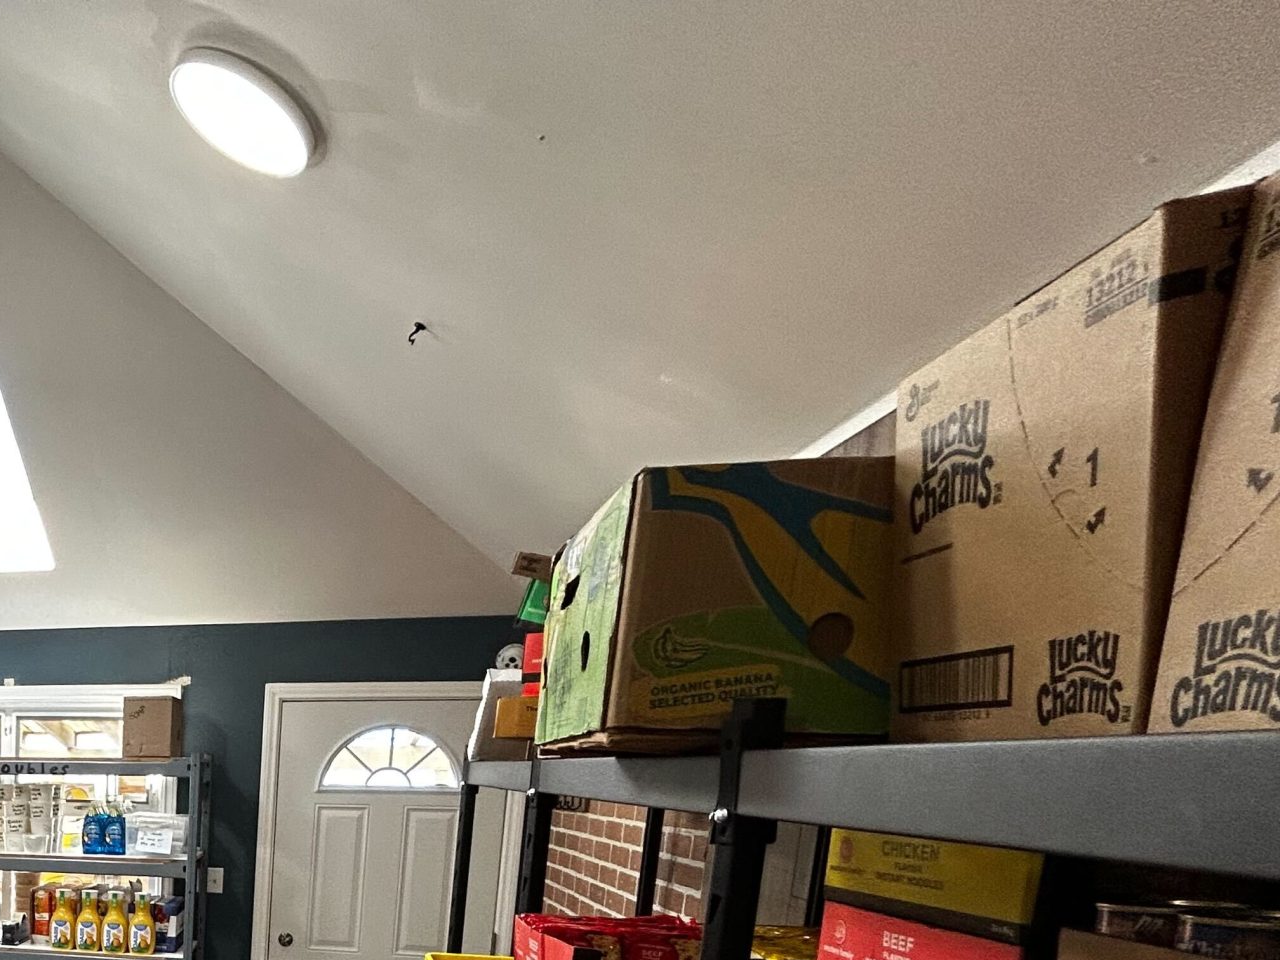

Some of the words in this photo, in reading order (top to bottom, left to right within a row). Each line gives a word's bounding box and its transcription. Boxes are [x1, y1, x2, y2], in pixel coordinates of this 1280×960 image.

[921, 400, 991, 481] Lucky
[1086, 447, 1099, 487] 1
[910, 452, 996, 533] Charms
[1048, 630, 1120, 684] Lucky
[649, 692, 715, 709] SELECTED
[718, 684, 780, 703] QUALITY
[650, 680, 710, 697] ORGANIC
[715, 673, 773, 689] BANANA
[1036, 677, 1122, 727] Charms
[882, 840, 940, 860] CHICKEN
[882, 930, 914, 952] BEEF
